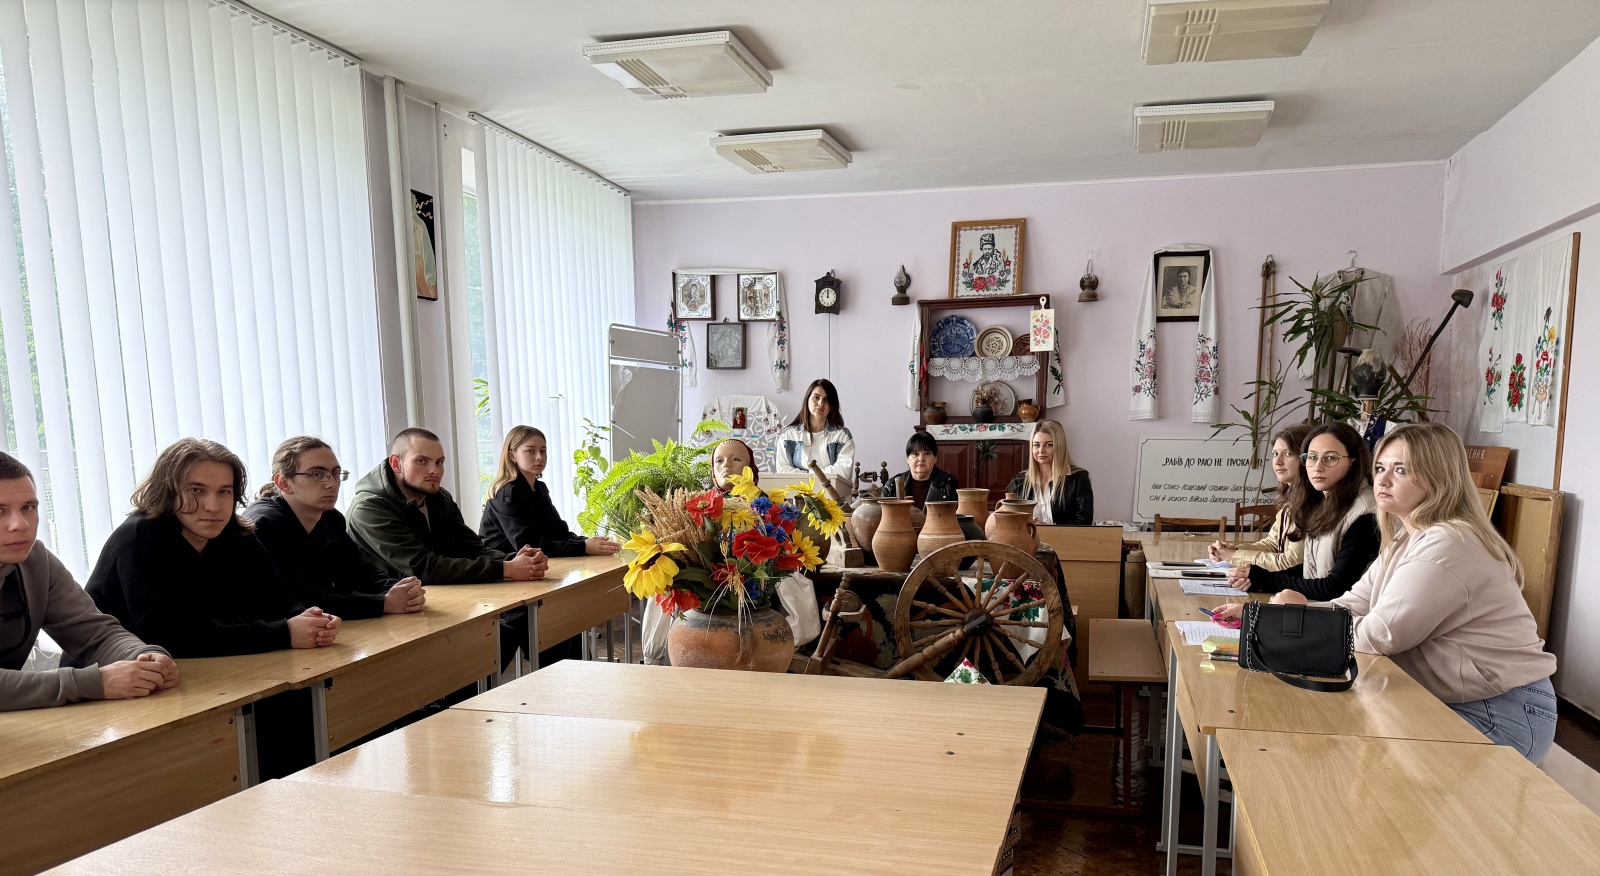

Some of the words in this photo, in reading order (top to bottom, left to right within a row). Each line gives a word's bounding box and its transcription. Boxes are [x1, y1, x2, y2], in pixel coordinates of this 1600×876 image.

[1184, 457, 1196, 469] ДО
[1197, 457, 1213, 467] РАЮ
[1214, 457, 1224, 467] НЕ
